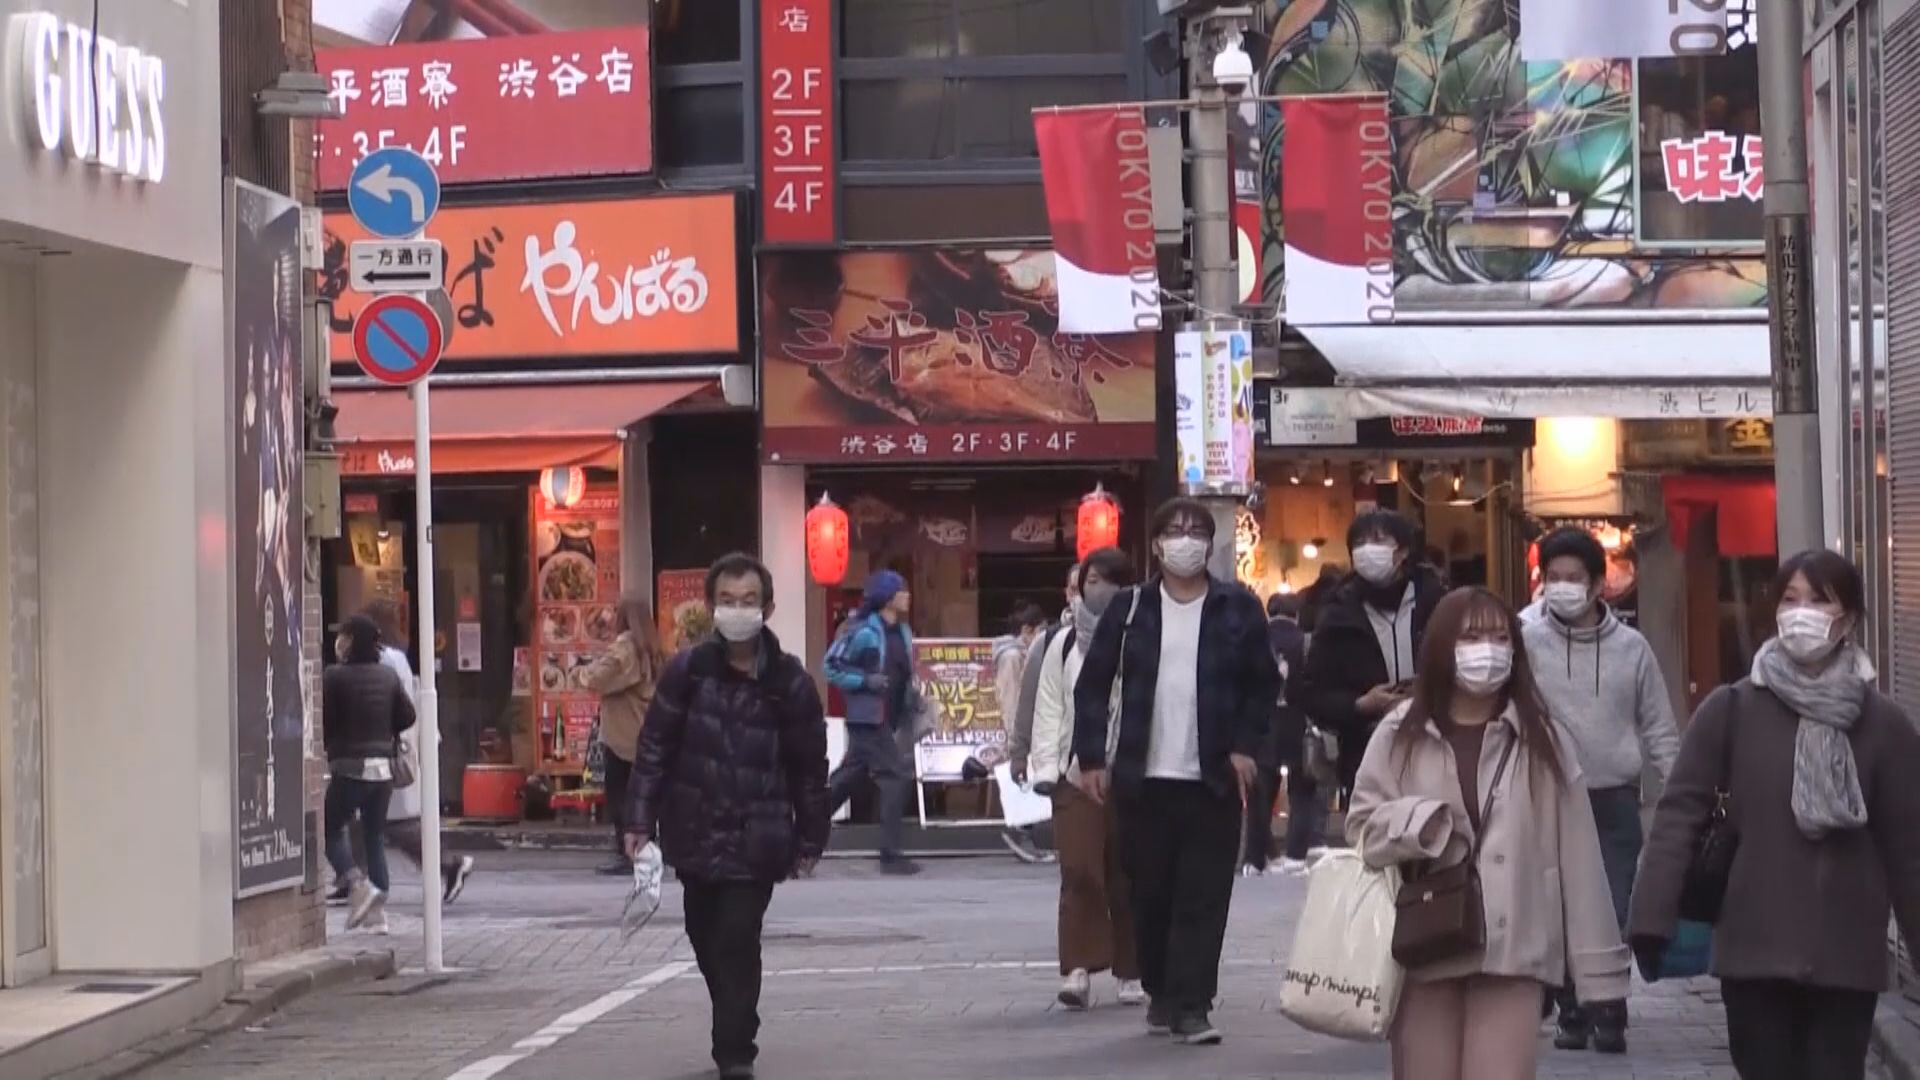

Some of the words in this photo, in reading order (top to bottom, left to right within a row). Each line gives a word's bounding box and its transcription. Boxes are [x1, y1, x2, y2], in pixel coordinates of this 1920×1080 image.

[780, 9, 808, 33] 店
[33, 12, 165, 184] GUESS
[498, 46, 634, 99] 渋谷店
[772, 69, 821, 100] 2F
[773, 125, 822, 157] 3F
[1358, 101, 1393, 221] TOKYO
[1117, 105, 1153, 231] TOKYO
[774, 181, 824, 213] 4F
[357, 246, 433, 266] 一方通行
[520, 219, 709, 337] やんばる
[1364, 239, 1395, 323] 2020
[1125, 240, 1161, 330] 2020
[840, 433, 928, 455] 渋谷店
